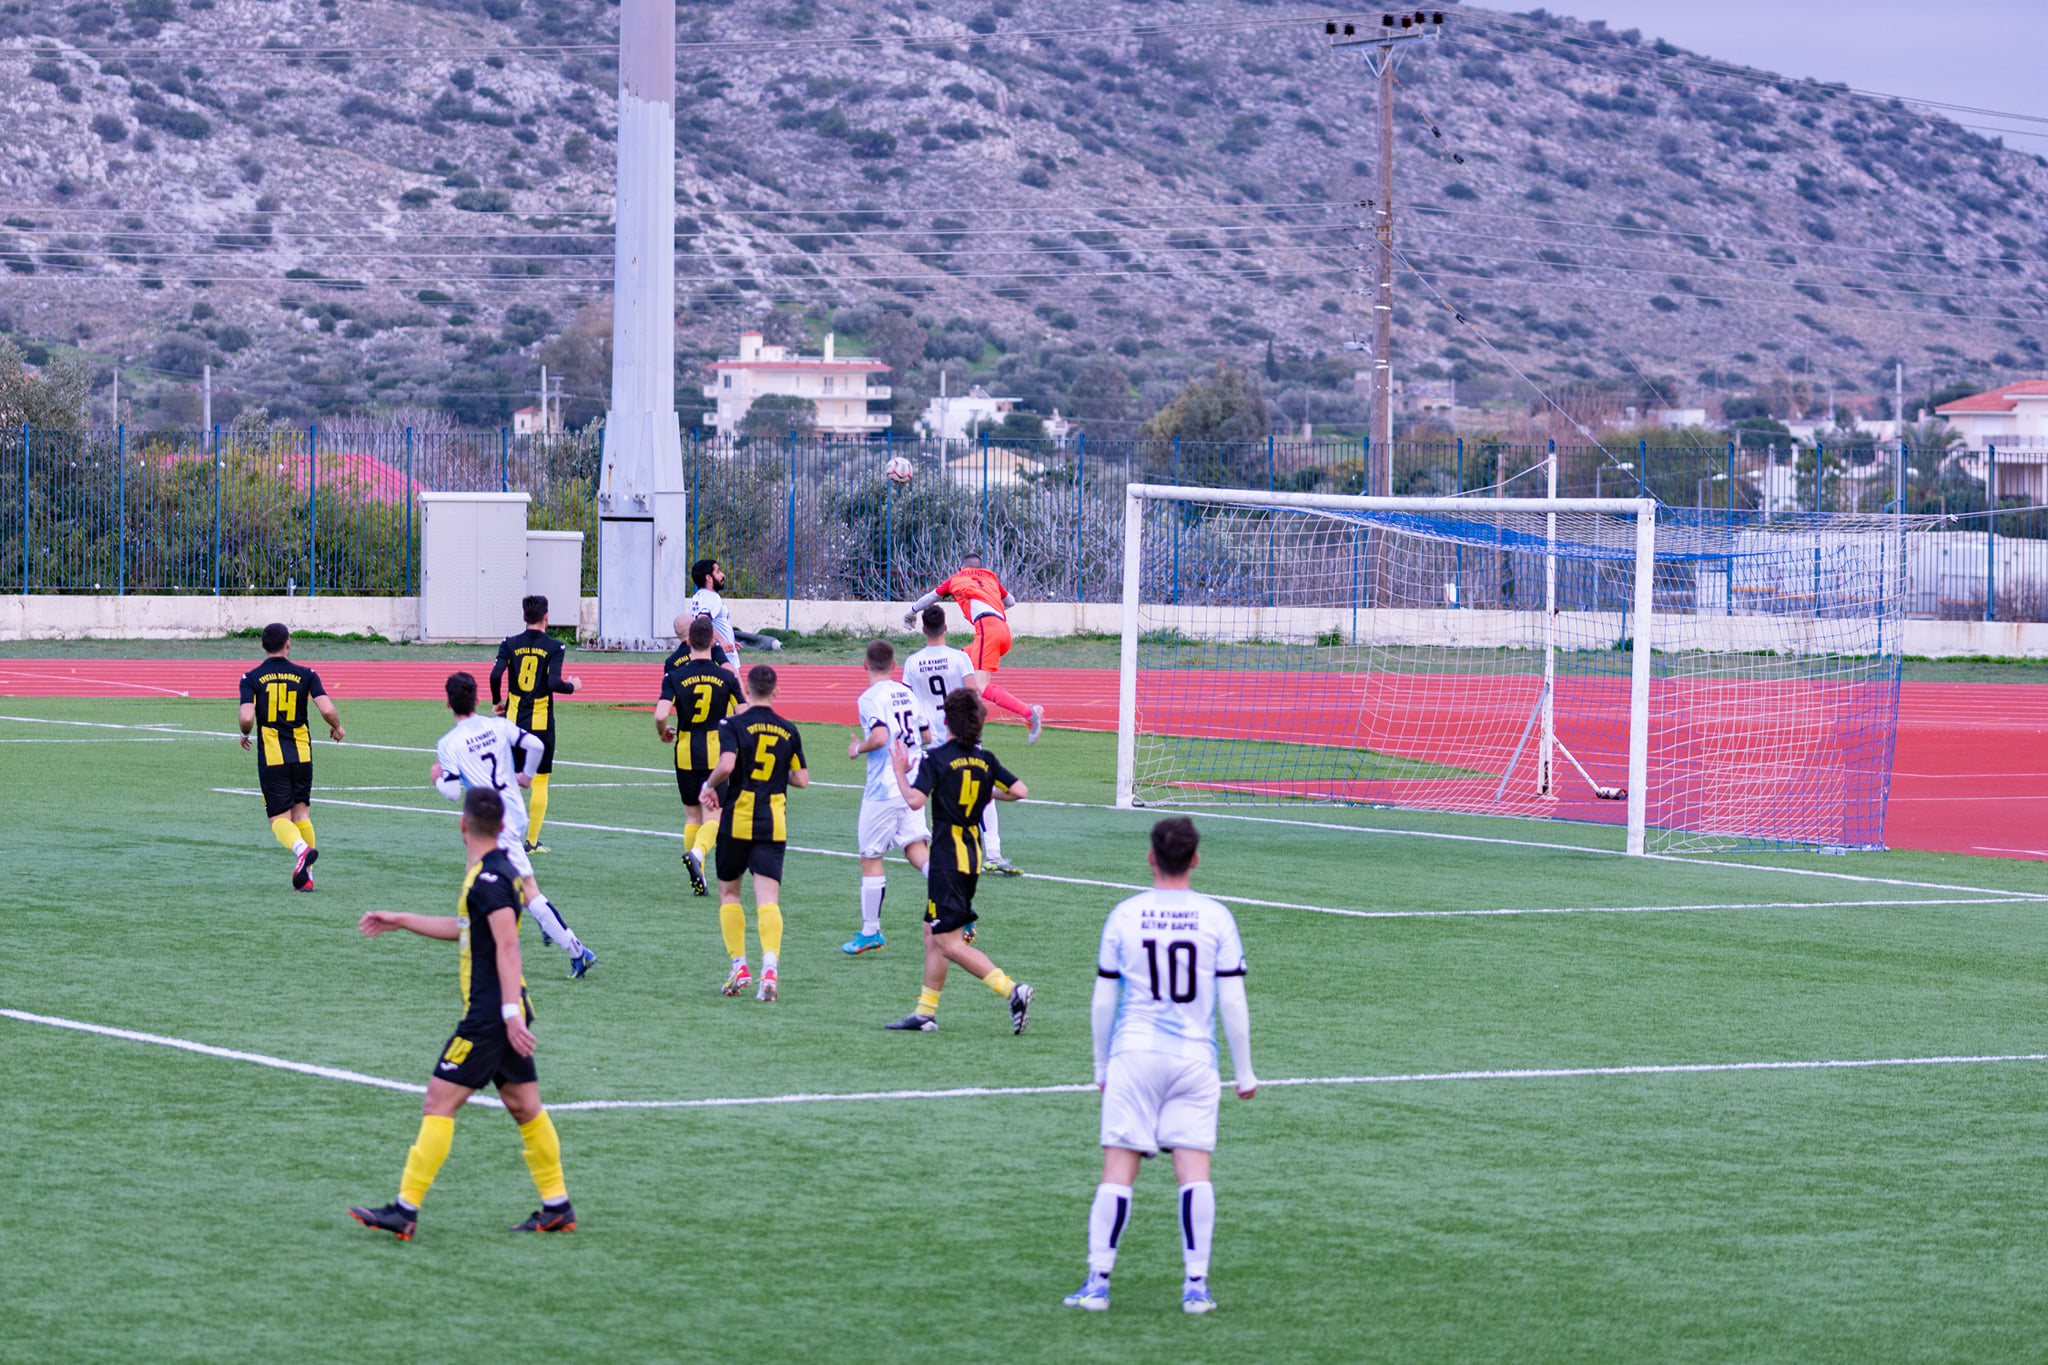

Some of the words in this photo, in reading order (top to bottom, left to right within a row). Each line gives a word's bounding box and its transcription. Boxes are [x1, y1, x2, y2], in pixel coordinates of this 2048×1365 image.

[518, 656, 538, 692] 8
[929, 674, 947, 711] 9
[266, 682, 297, 722] 14
[691, 684, 713, 723] 3
[751, 733, 779, 781] 5
[959, 769, 980, 818] 4
[1142, 939, 1197, 1004] 10
